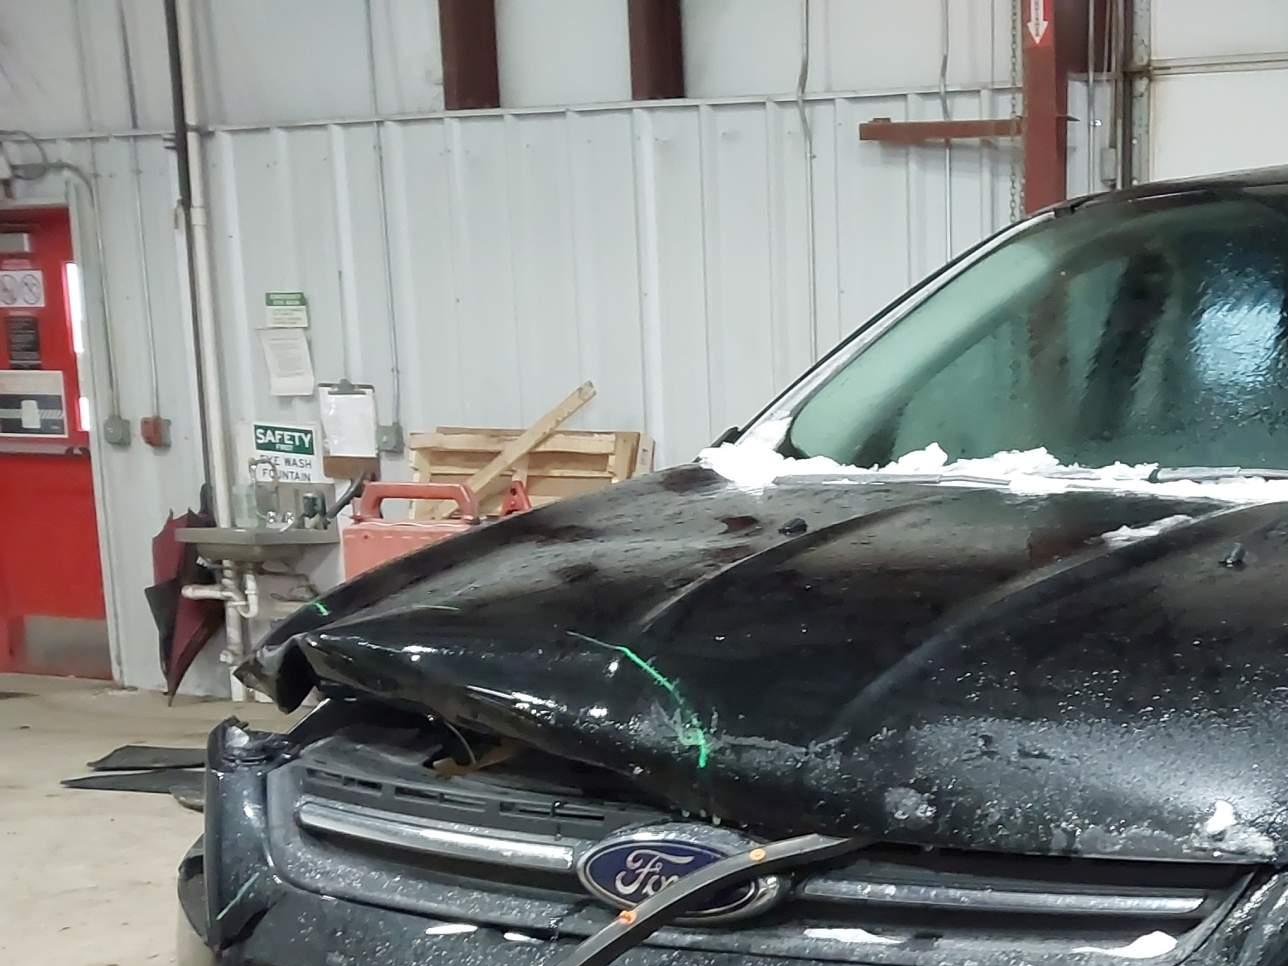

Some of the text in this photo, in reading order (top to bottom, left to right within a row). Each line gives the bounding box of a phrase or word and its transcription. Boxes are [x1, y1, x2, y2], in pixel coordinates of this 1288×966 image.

[256, 429, 311, 448] SAFETY
[285, 458, 311, 468] WASH
[615, 849, 695, 896] Fo
